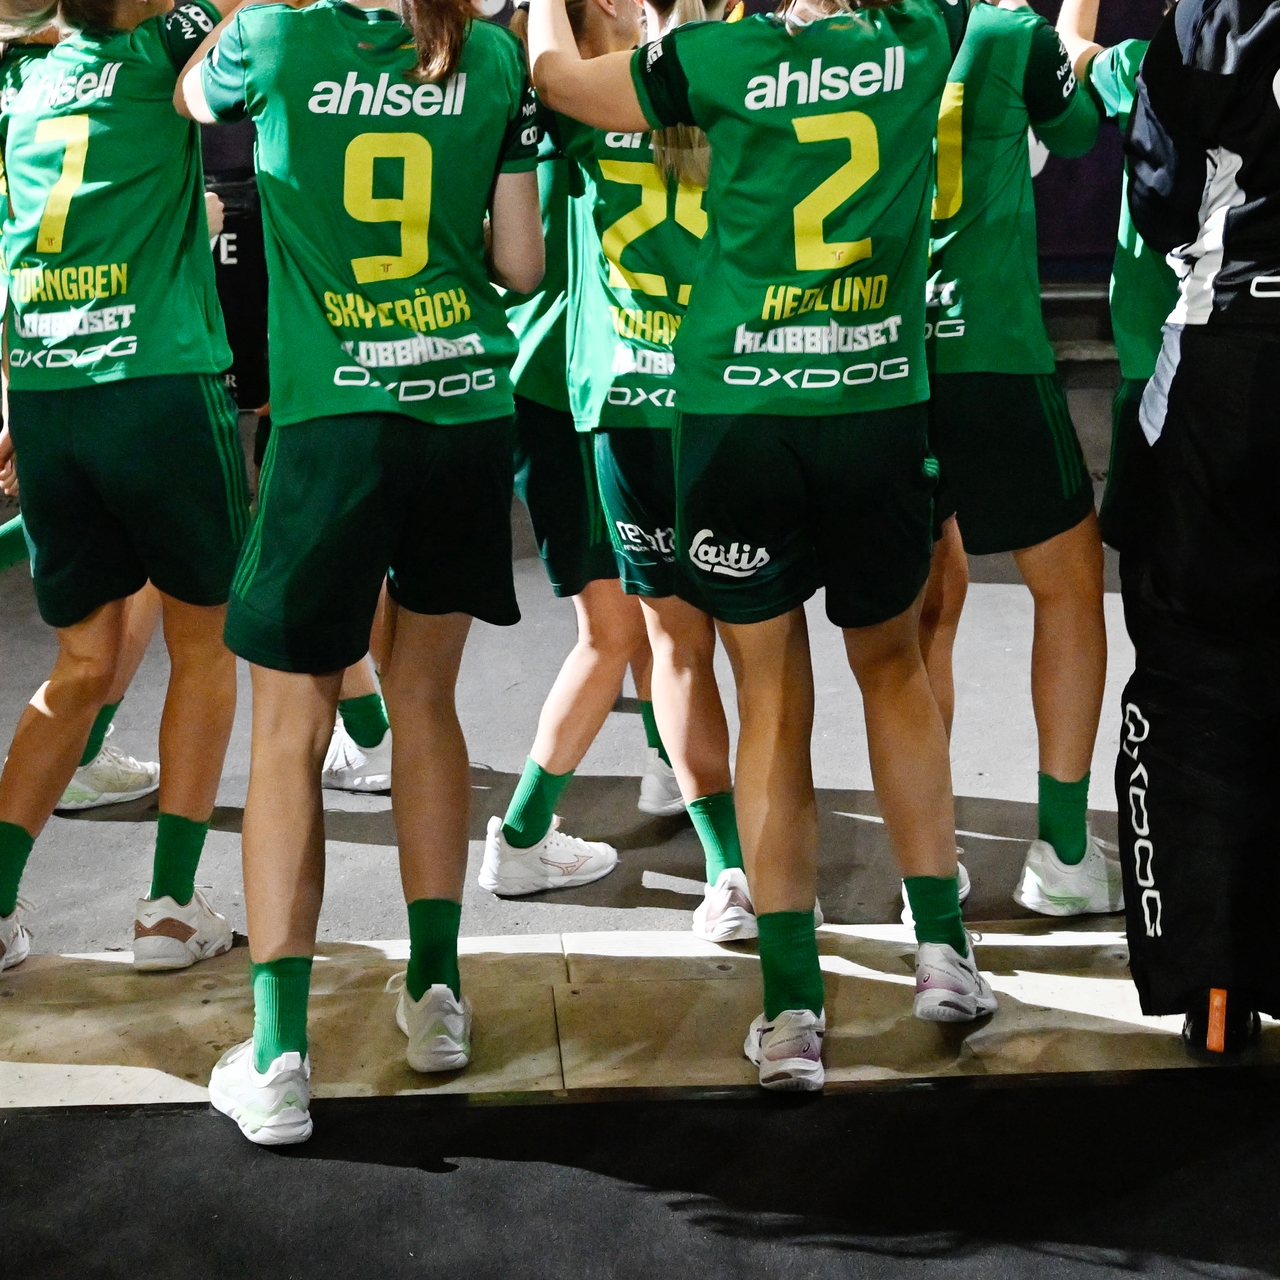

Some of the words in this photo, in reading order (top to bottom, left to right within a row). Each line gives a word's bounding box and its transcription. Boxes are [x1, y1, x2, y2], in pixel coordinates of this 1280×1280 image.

[307, 71, 467, 117] ahlsell
[744, 45, 906, 111] ahlsell
[34, 113, 90, 254] 7
[791, 110, 881, 272] 2
[343, 131, 433, 285] 9
[10, 261, 128, 305] TÖRNGREN
[761, 273, 889, 321] HEDLUND
[9, 335, 138, 369] OXDOG
[723, 356, 910, 389] OXDOG
